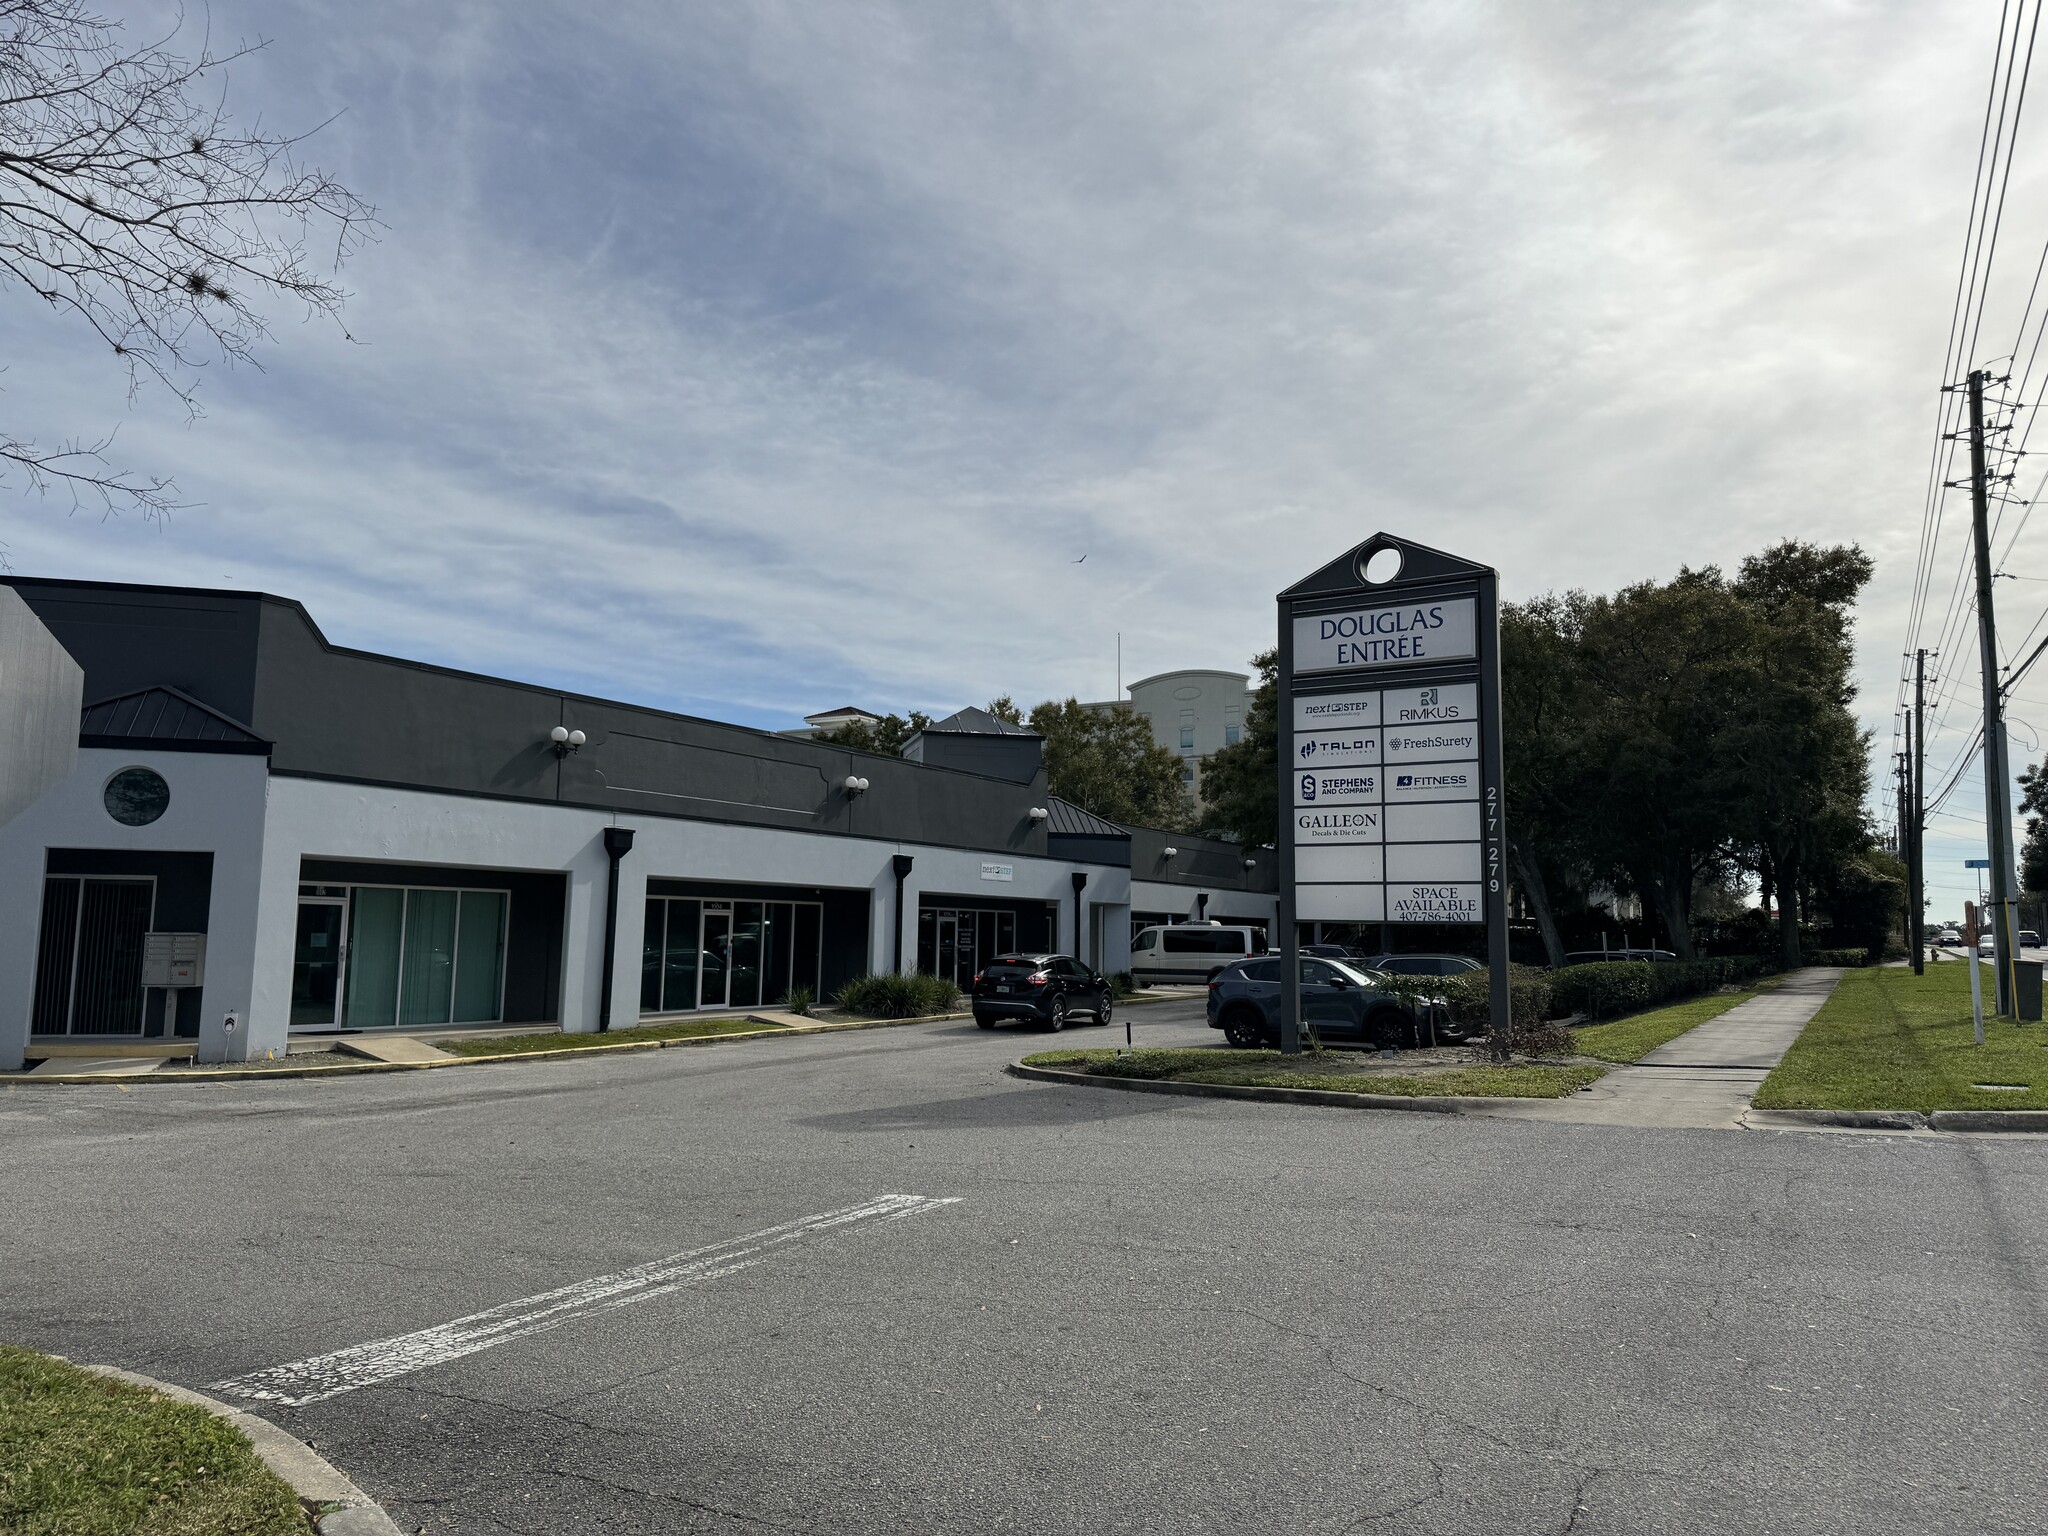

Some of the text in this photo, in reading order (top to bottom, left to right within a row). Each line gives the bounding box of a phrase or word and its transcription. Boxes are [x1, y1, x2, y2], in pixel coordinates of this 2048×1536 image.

[1320, 606, 1444, 640] DOUGLAS
[1337, 634, 1426, 664] ENTRÉE
[1305, 702, 1368, 714] next STEP
[1400, 706, 1459, 720] RIMKUS
[1320, 740, 1375, 751] TALON
[1404, 737, 1472, 750] FreshSurety
[1322, 777, 1374, 788] STEPHENS
[1414, 775, 1467, 786] FITNESS
[1298, 814, 1377, 828] GALLEON
[1412, 887, 1459, 899] SPACE
[1394, 899, 1477, 912] AVAILABLE
[1399, 912, 1471, 922] 407-786-4001
